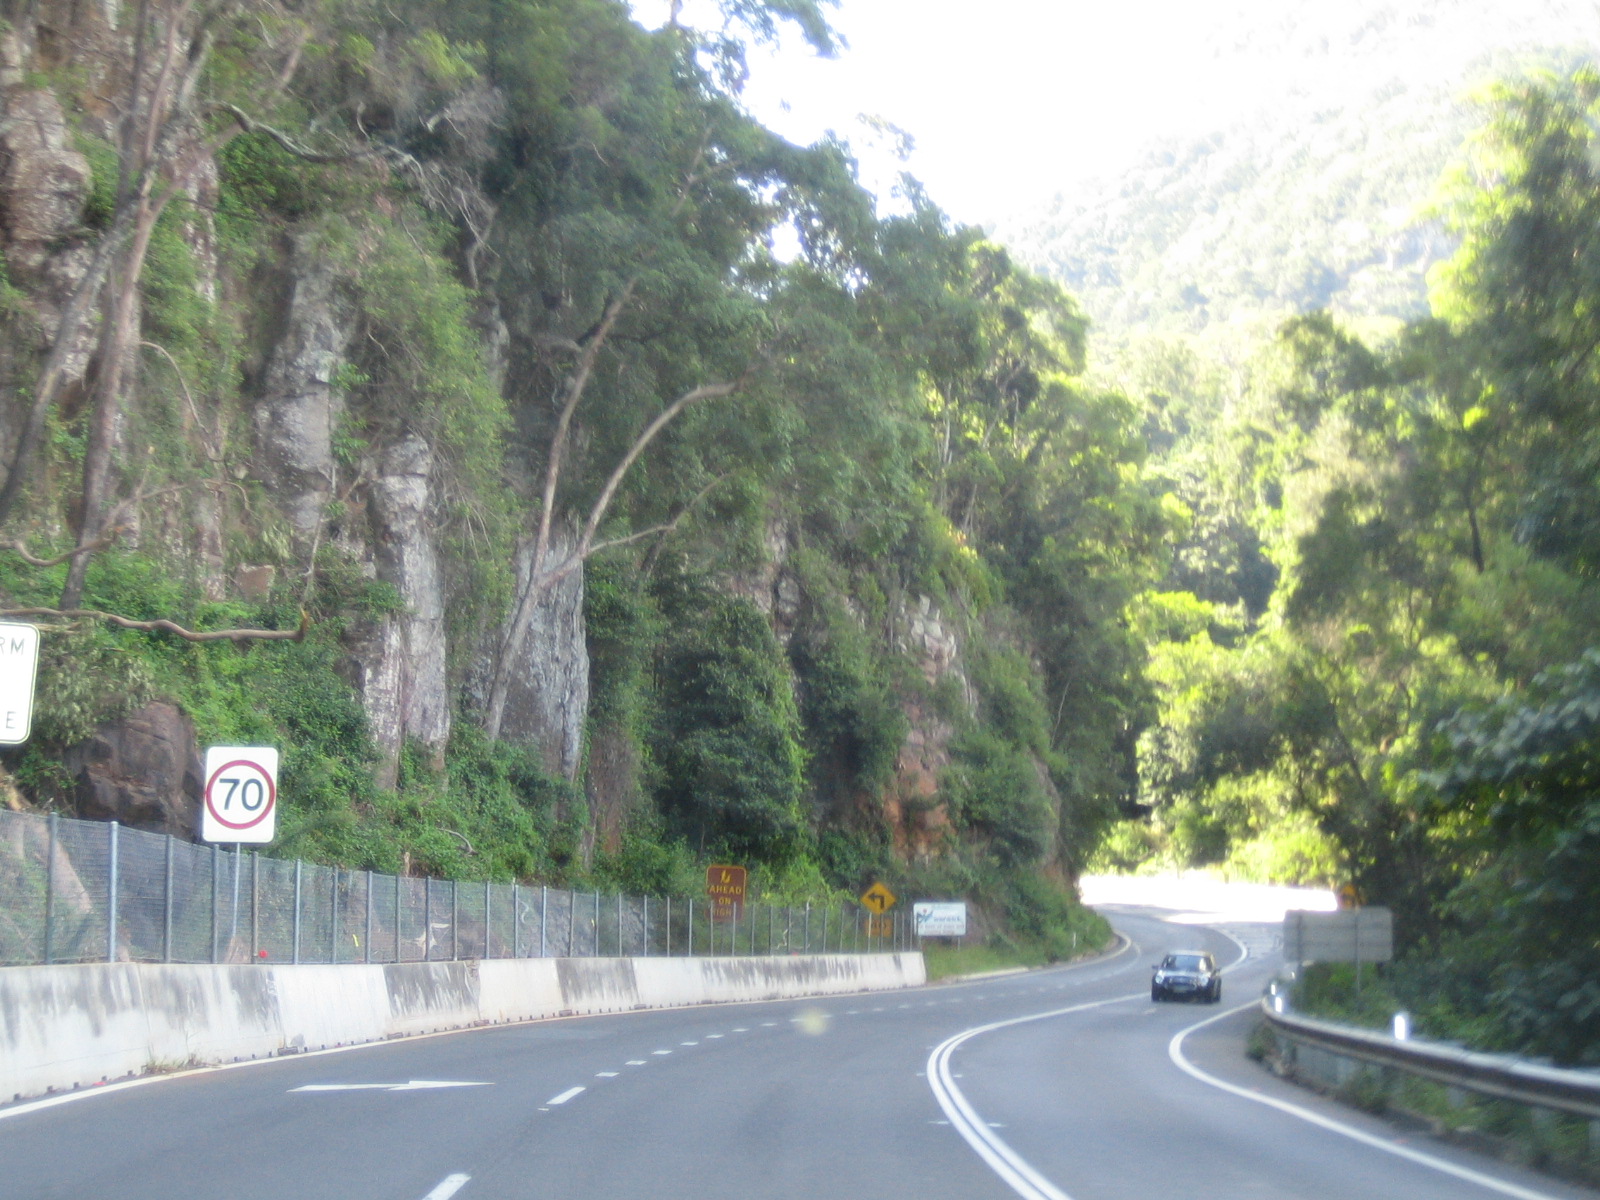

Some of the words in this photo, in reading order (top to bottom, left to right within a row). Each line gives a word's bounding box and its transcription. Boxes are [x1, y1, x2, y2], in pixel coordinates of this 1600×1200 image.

[219, 778, 263, 811] 70
[709, 885, 742, 894] AHEAD
[718, 897, 732, 905] ON
